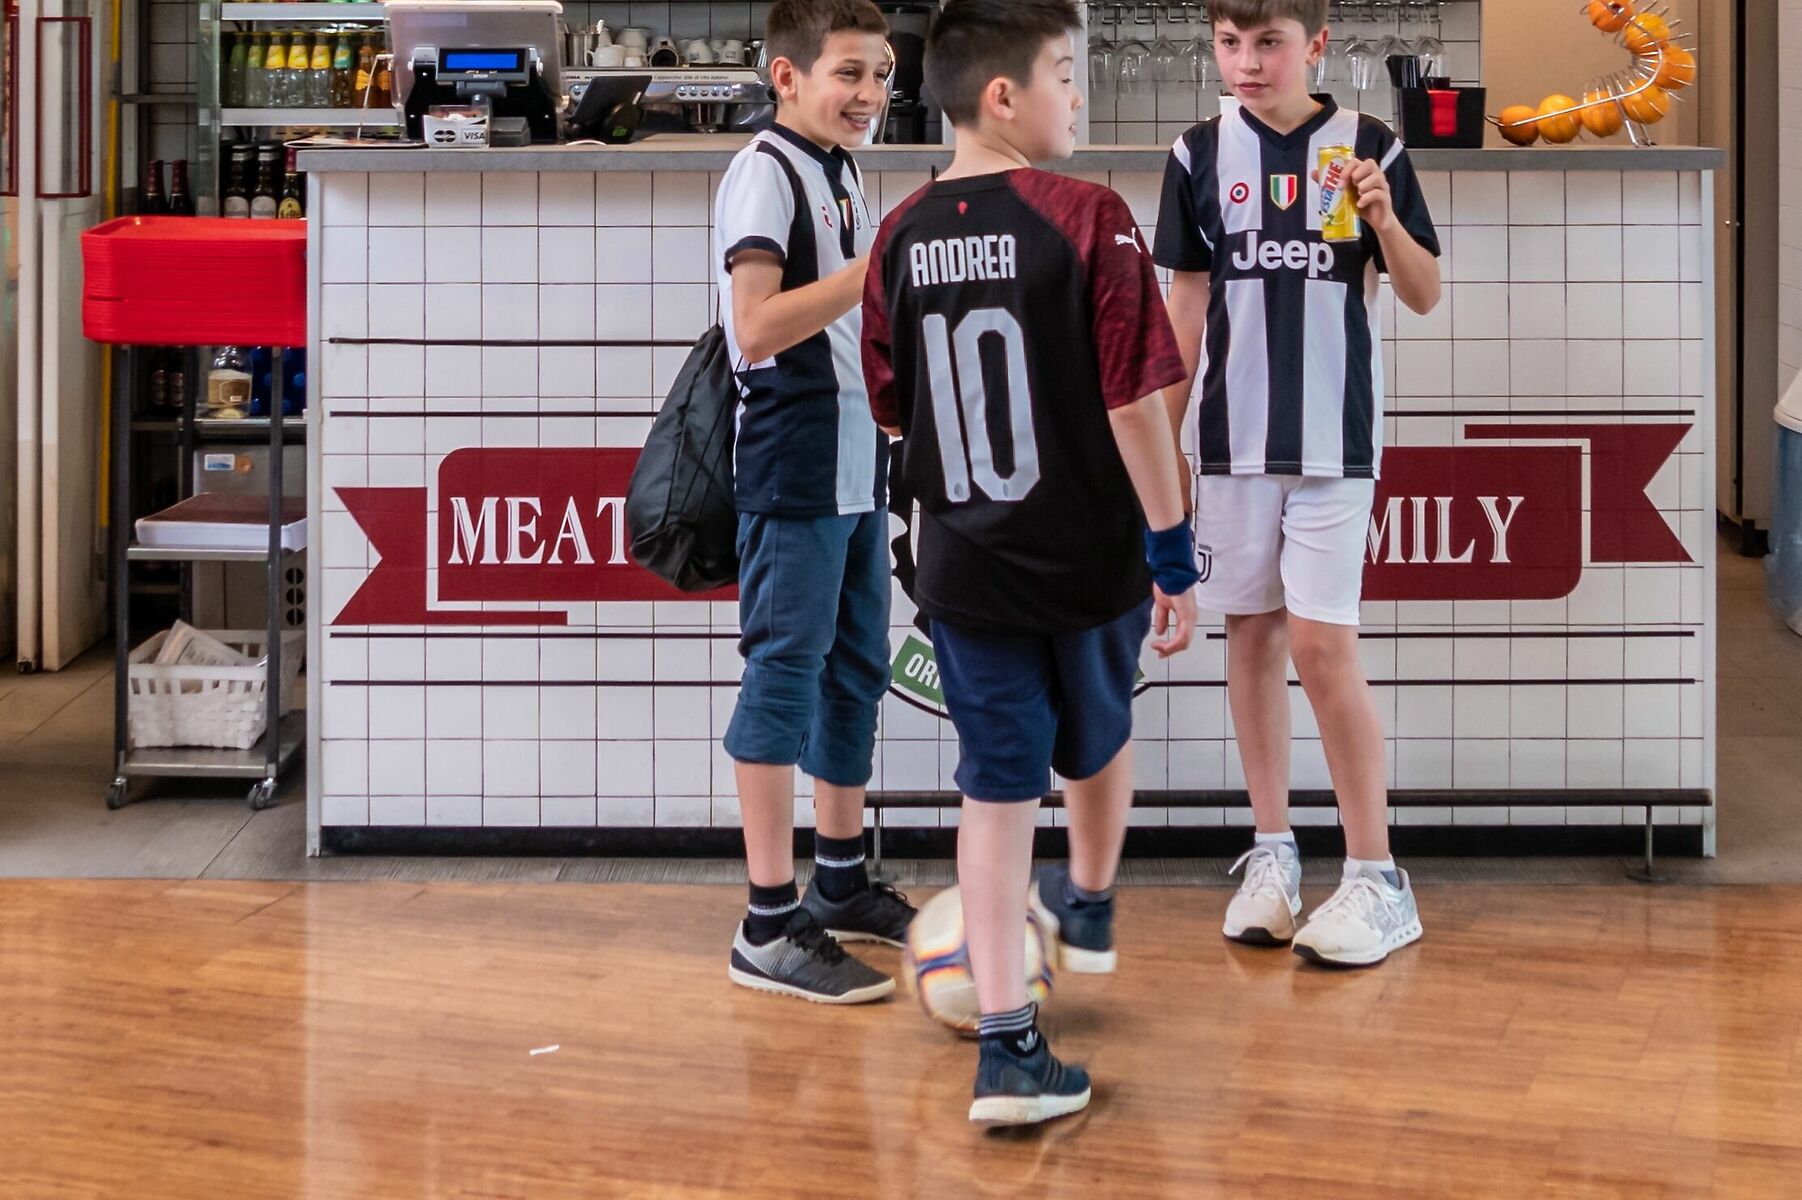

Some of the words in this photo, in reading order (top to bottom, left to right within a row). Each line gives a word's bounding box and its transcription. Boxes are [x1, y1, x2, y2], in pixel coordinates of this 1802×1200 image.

[464, 132, 486, 140] VISA
[909, 234, 1016, 287] ANDREA
[1232, 231, 1335, 278] Jeep
[922, 307, 1041, 502] 10
[447, 495, 630, 566] MEAT
[1364, 496, 1525, 566] MILY
